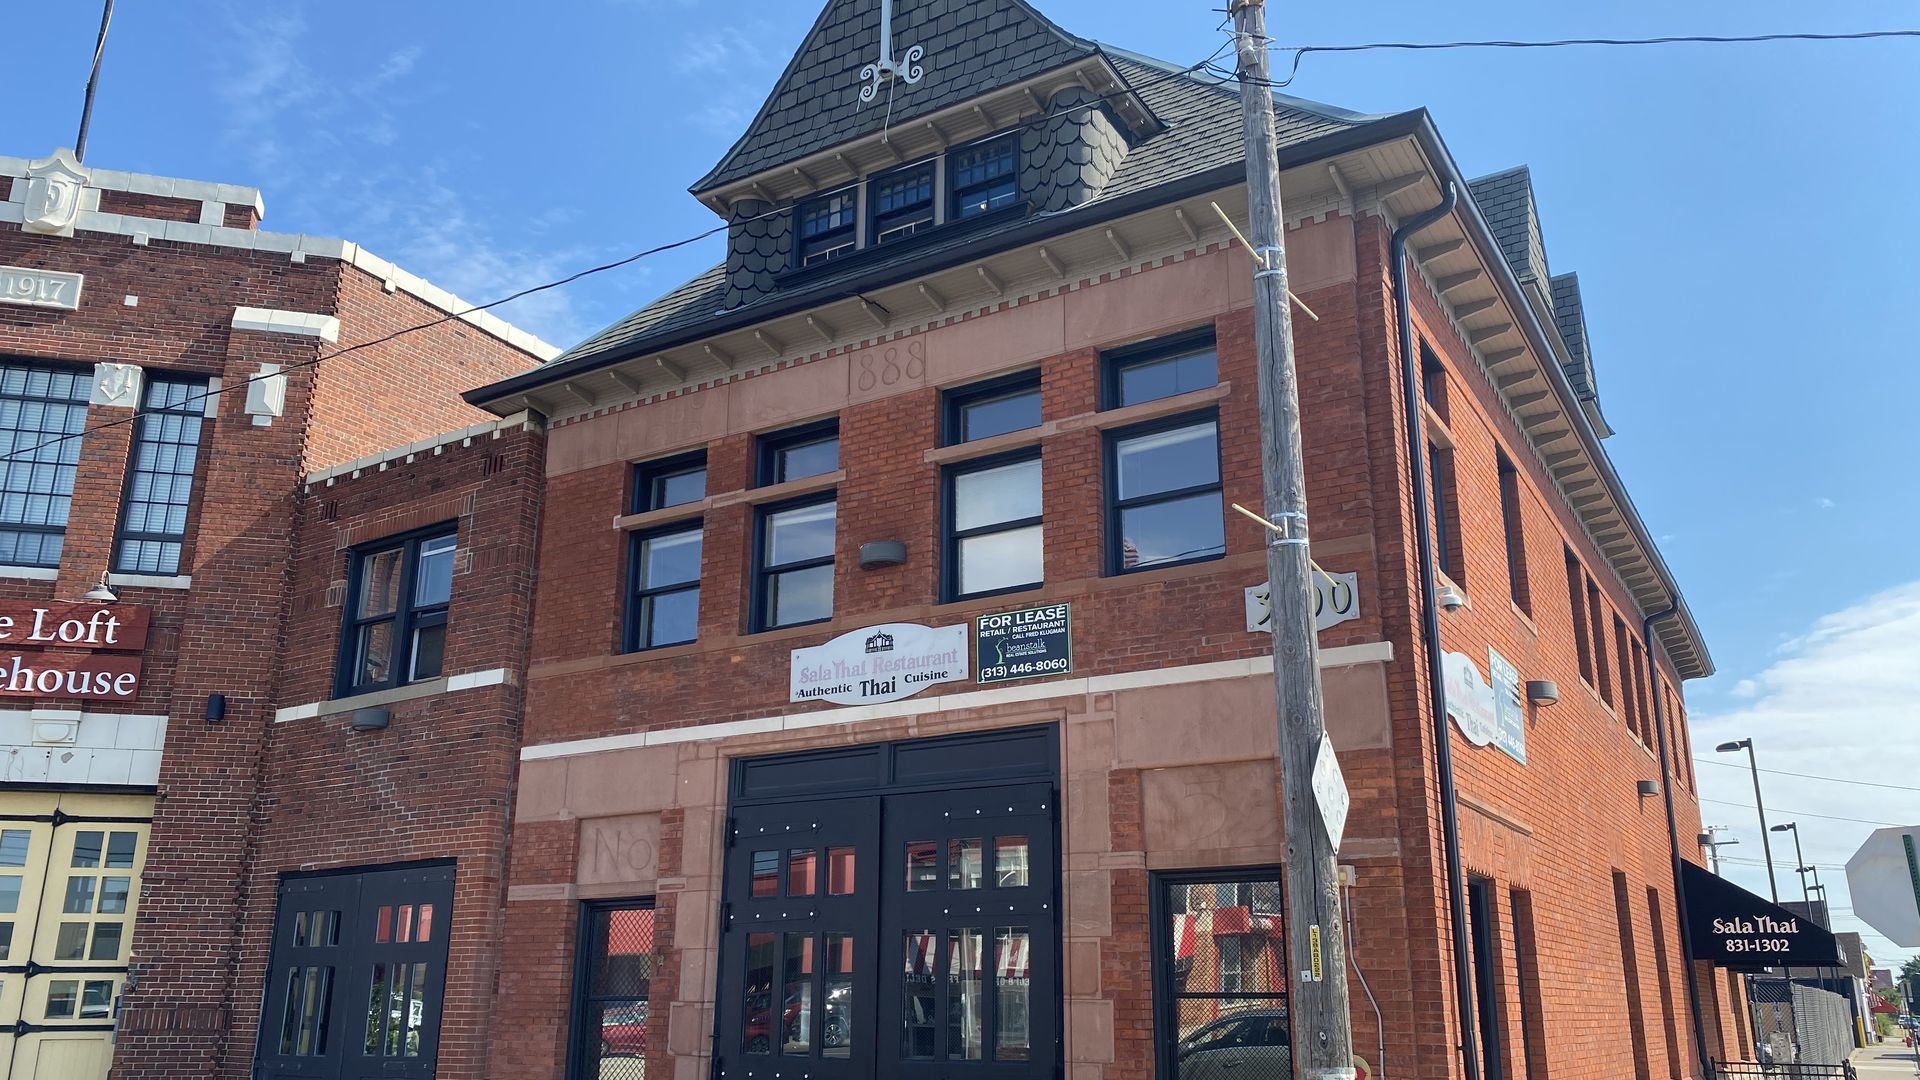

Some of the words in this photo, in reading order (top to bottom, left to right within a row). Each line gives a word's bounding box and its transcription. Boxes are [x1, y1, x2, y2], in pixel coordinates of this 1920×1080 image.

[5, 275, 67, 301] 1917
[27, 608, 120, 644] Loft
[980, 615, 1011, 630] FOR
[1016, 607, 1066, 625] LEASE
[980, 628, 1006, 638] RETAIL
[1012, 620, 1066, 633] RESTAURANT
[1006, 638, 1046, 653] beanstalk
[1012, 632, 1025, 640] CALL
[799, 664, 832, 684] Sala
[832, 660, 866, 680] Thai
[872, 648, 959, 674] Restaurant
[981, 665, 1008, 679] (313)
[1010, 658, 1067, 674] 446-8060
[797, 683, 853, 699] Authentic
[859, 676, 897, 697] Thai
[904, 670, 949, 684] Cuisine
[1712, 917, 1755, 934] Sala
[1753, 914, 1800, 934] Thai
[1726, 939, 1790, 952] 831-1302
